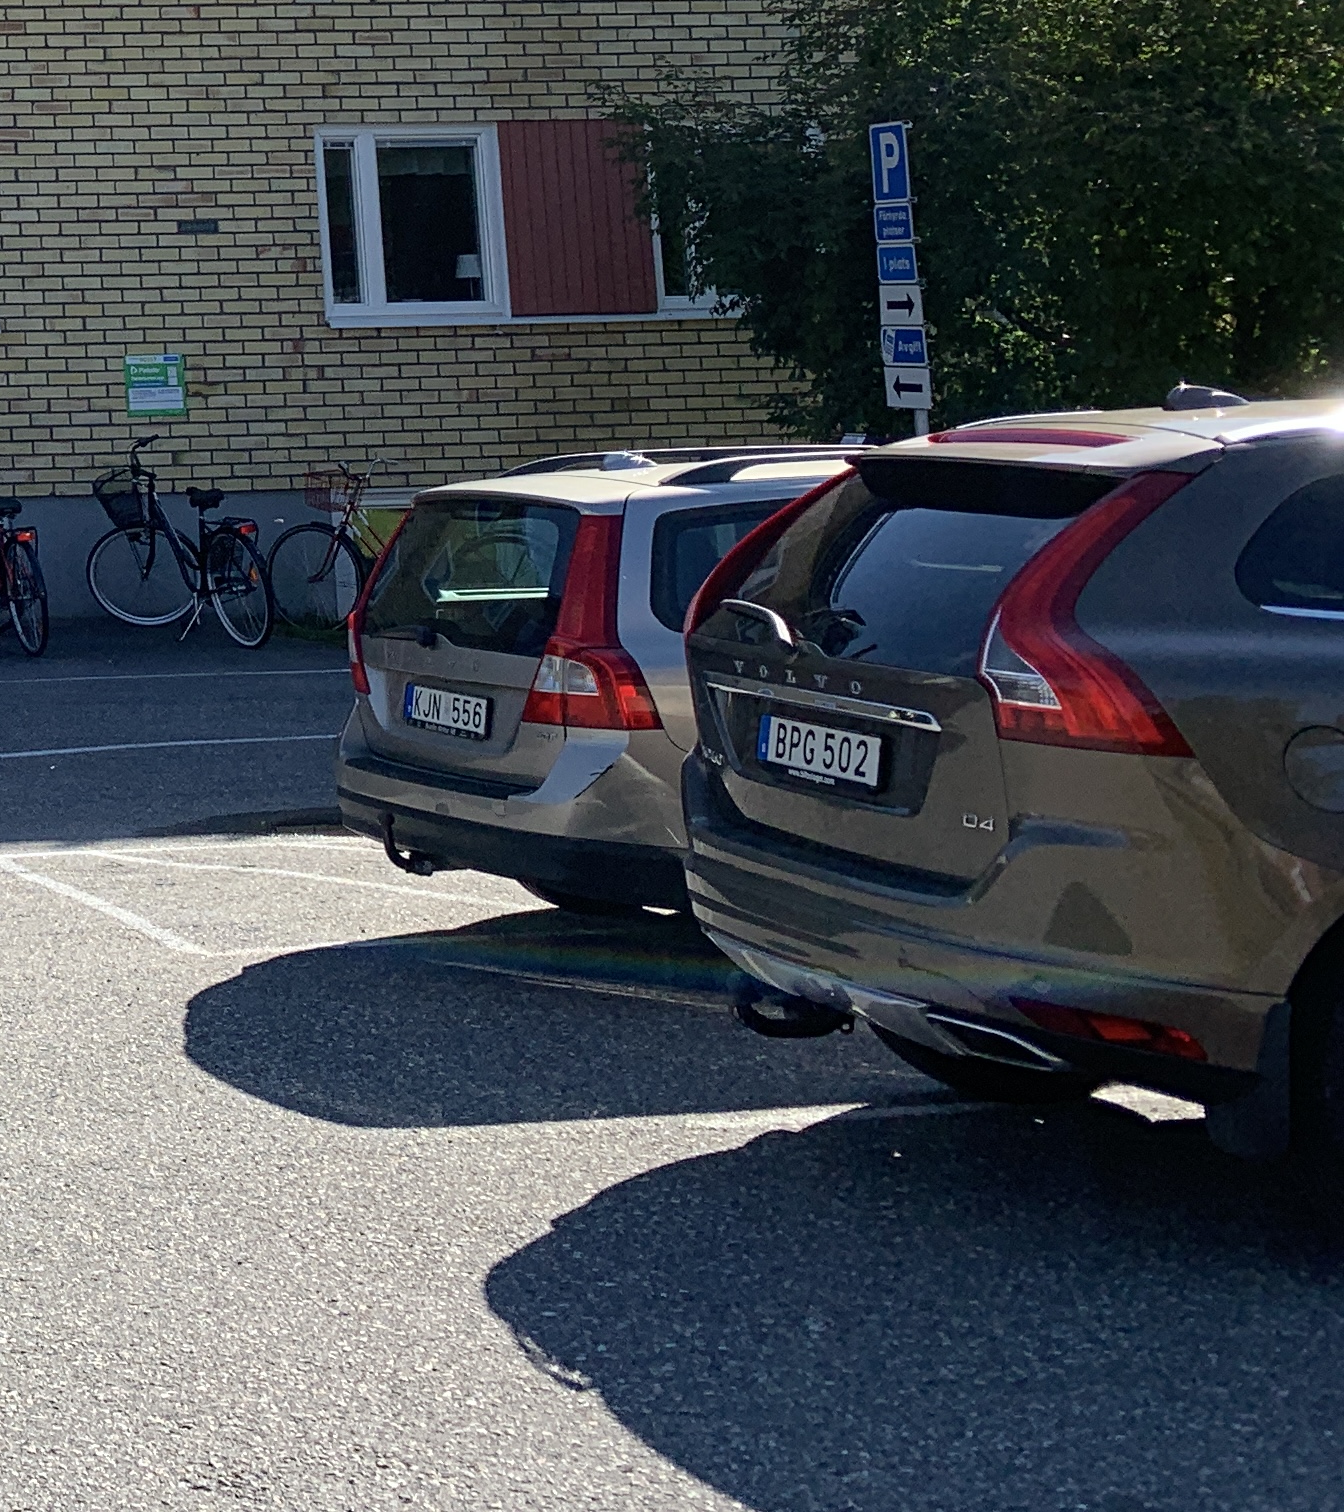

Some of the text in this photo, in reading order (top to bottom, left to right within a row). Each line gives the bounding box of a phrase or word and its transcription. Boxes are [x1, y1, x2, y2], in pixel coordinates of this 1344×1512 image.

[879, 132, 899, 193] P
[889, 256, 911, 272] plats
[733, 660, 862, 694] VOLVO
[414, 690, 442, 720] KJN
[452, 697, 482, 729] 556
[775, 723, 816, 765] BPG
[823, 732, 868, 778] 502
